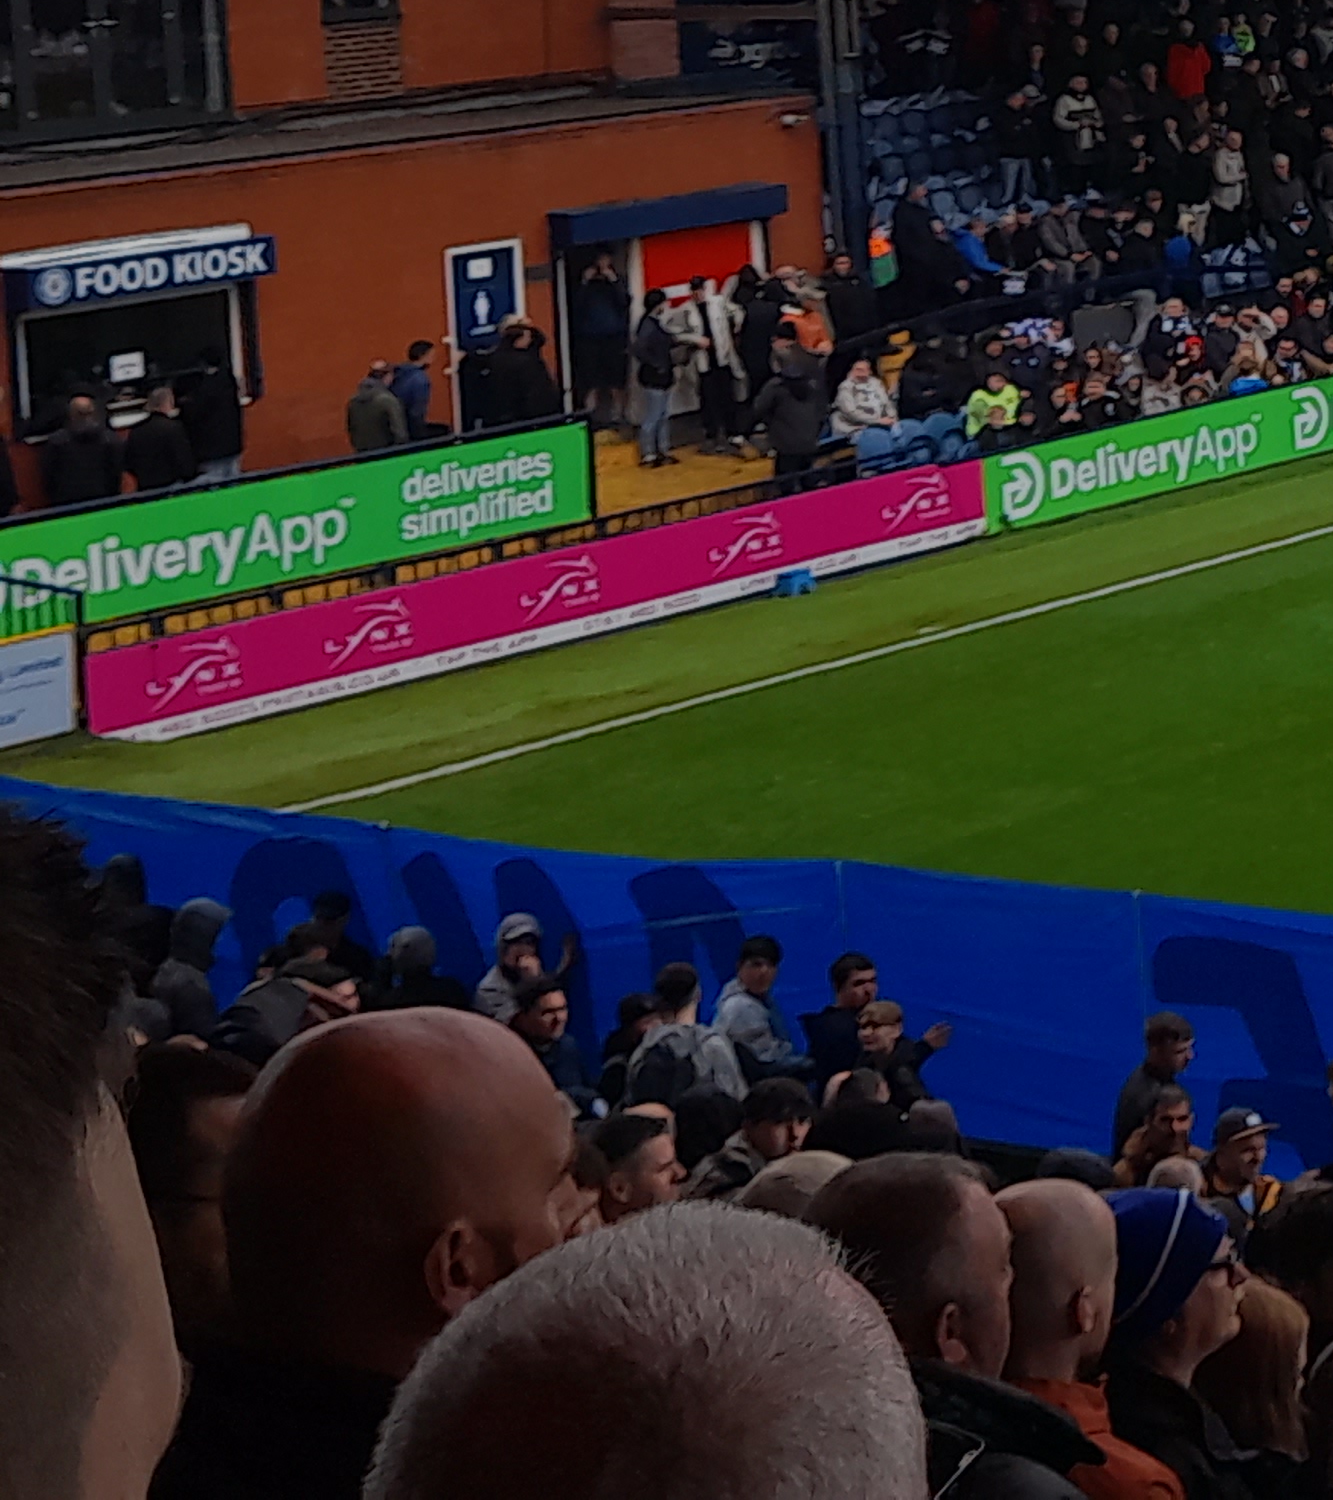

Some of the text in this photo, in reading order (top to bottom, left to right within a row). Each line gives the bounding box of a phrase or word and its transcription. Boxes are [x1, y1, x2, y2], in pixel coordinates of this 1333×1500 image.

[73, 241, 270, 300] FOOD KIOSK
[401, 450, 554, 503] deliveries
[1050, 419, 1259, 498] DeliveryApp
[400, 480, 555, 543] simplified
